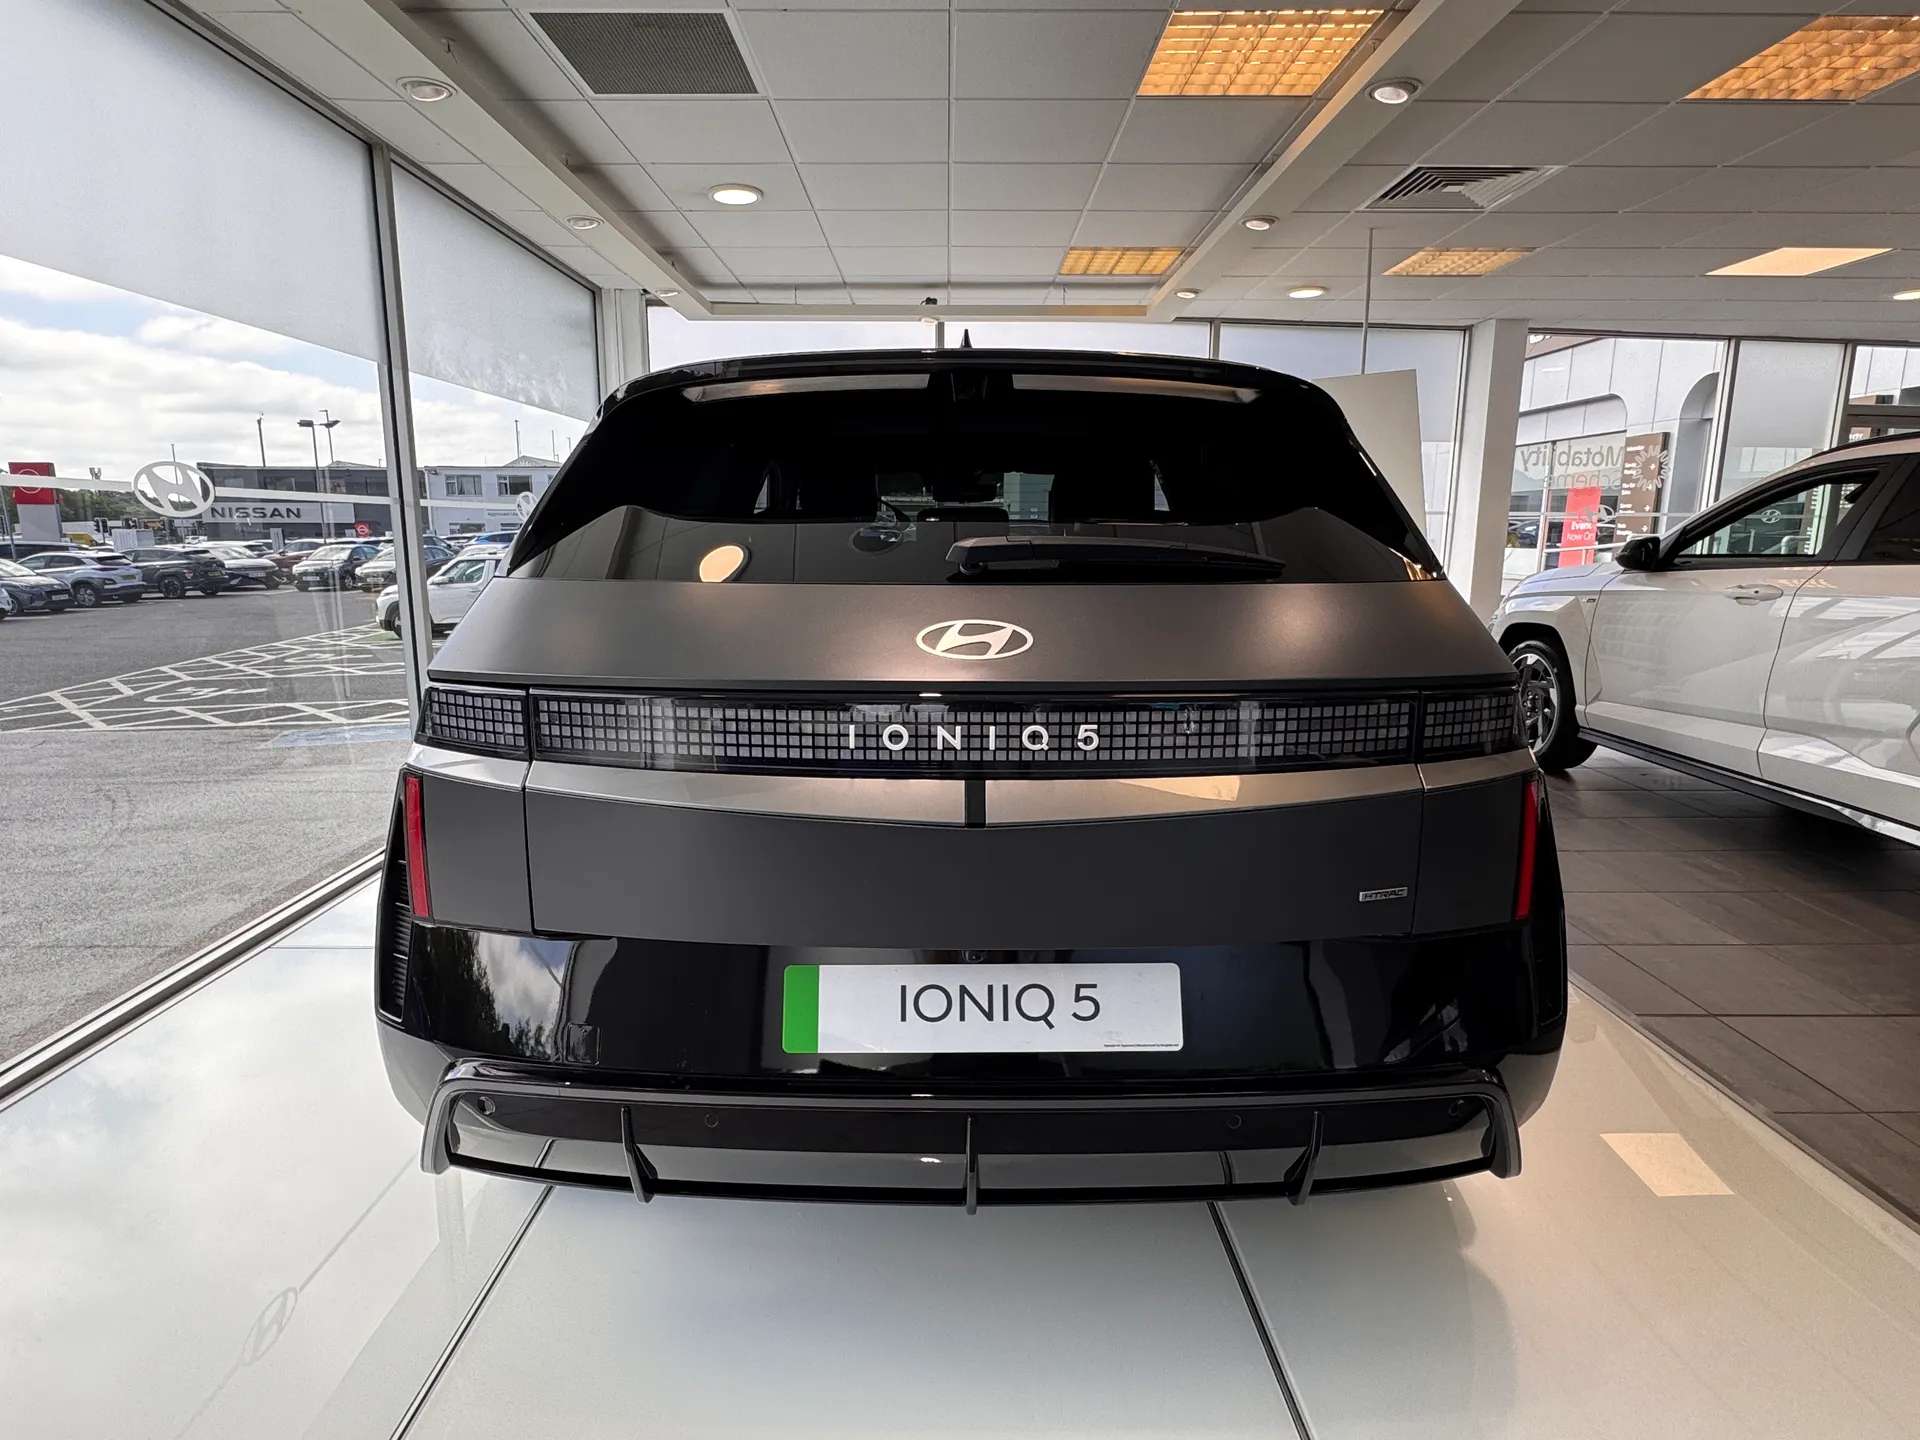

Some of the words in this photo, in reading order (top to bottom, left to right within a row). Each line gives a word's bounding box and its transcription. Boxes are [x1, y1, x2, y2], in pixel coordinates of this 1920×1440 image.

[211, 507, 301, 519] NISSAN
[849, 724, 1049, 751] IONIQ
[1077, 724, 1099, 751] 5
[900, 983, 1055, 1030] IONIQ
[1071, 983, 1101, 1022] 5
